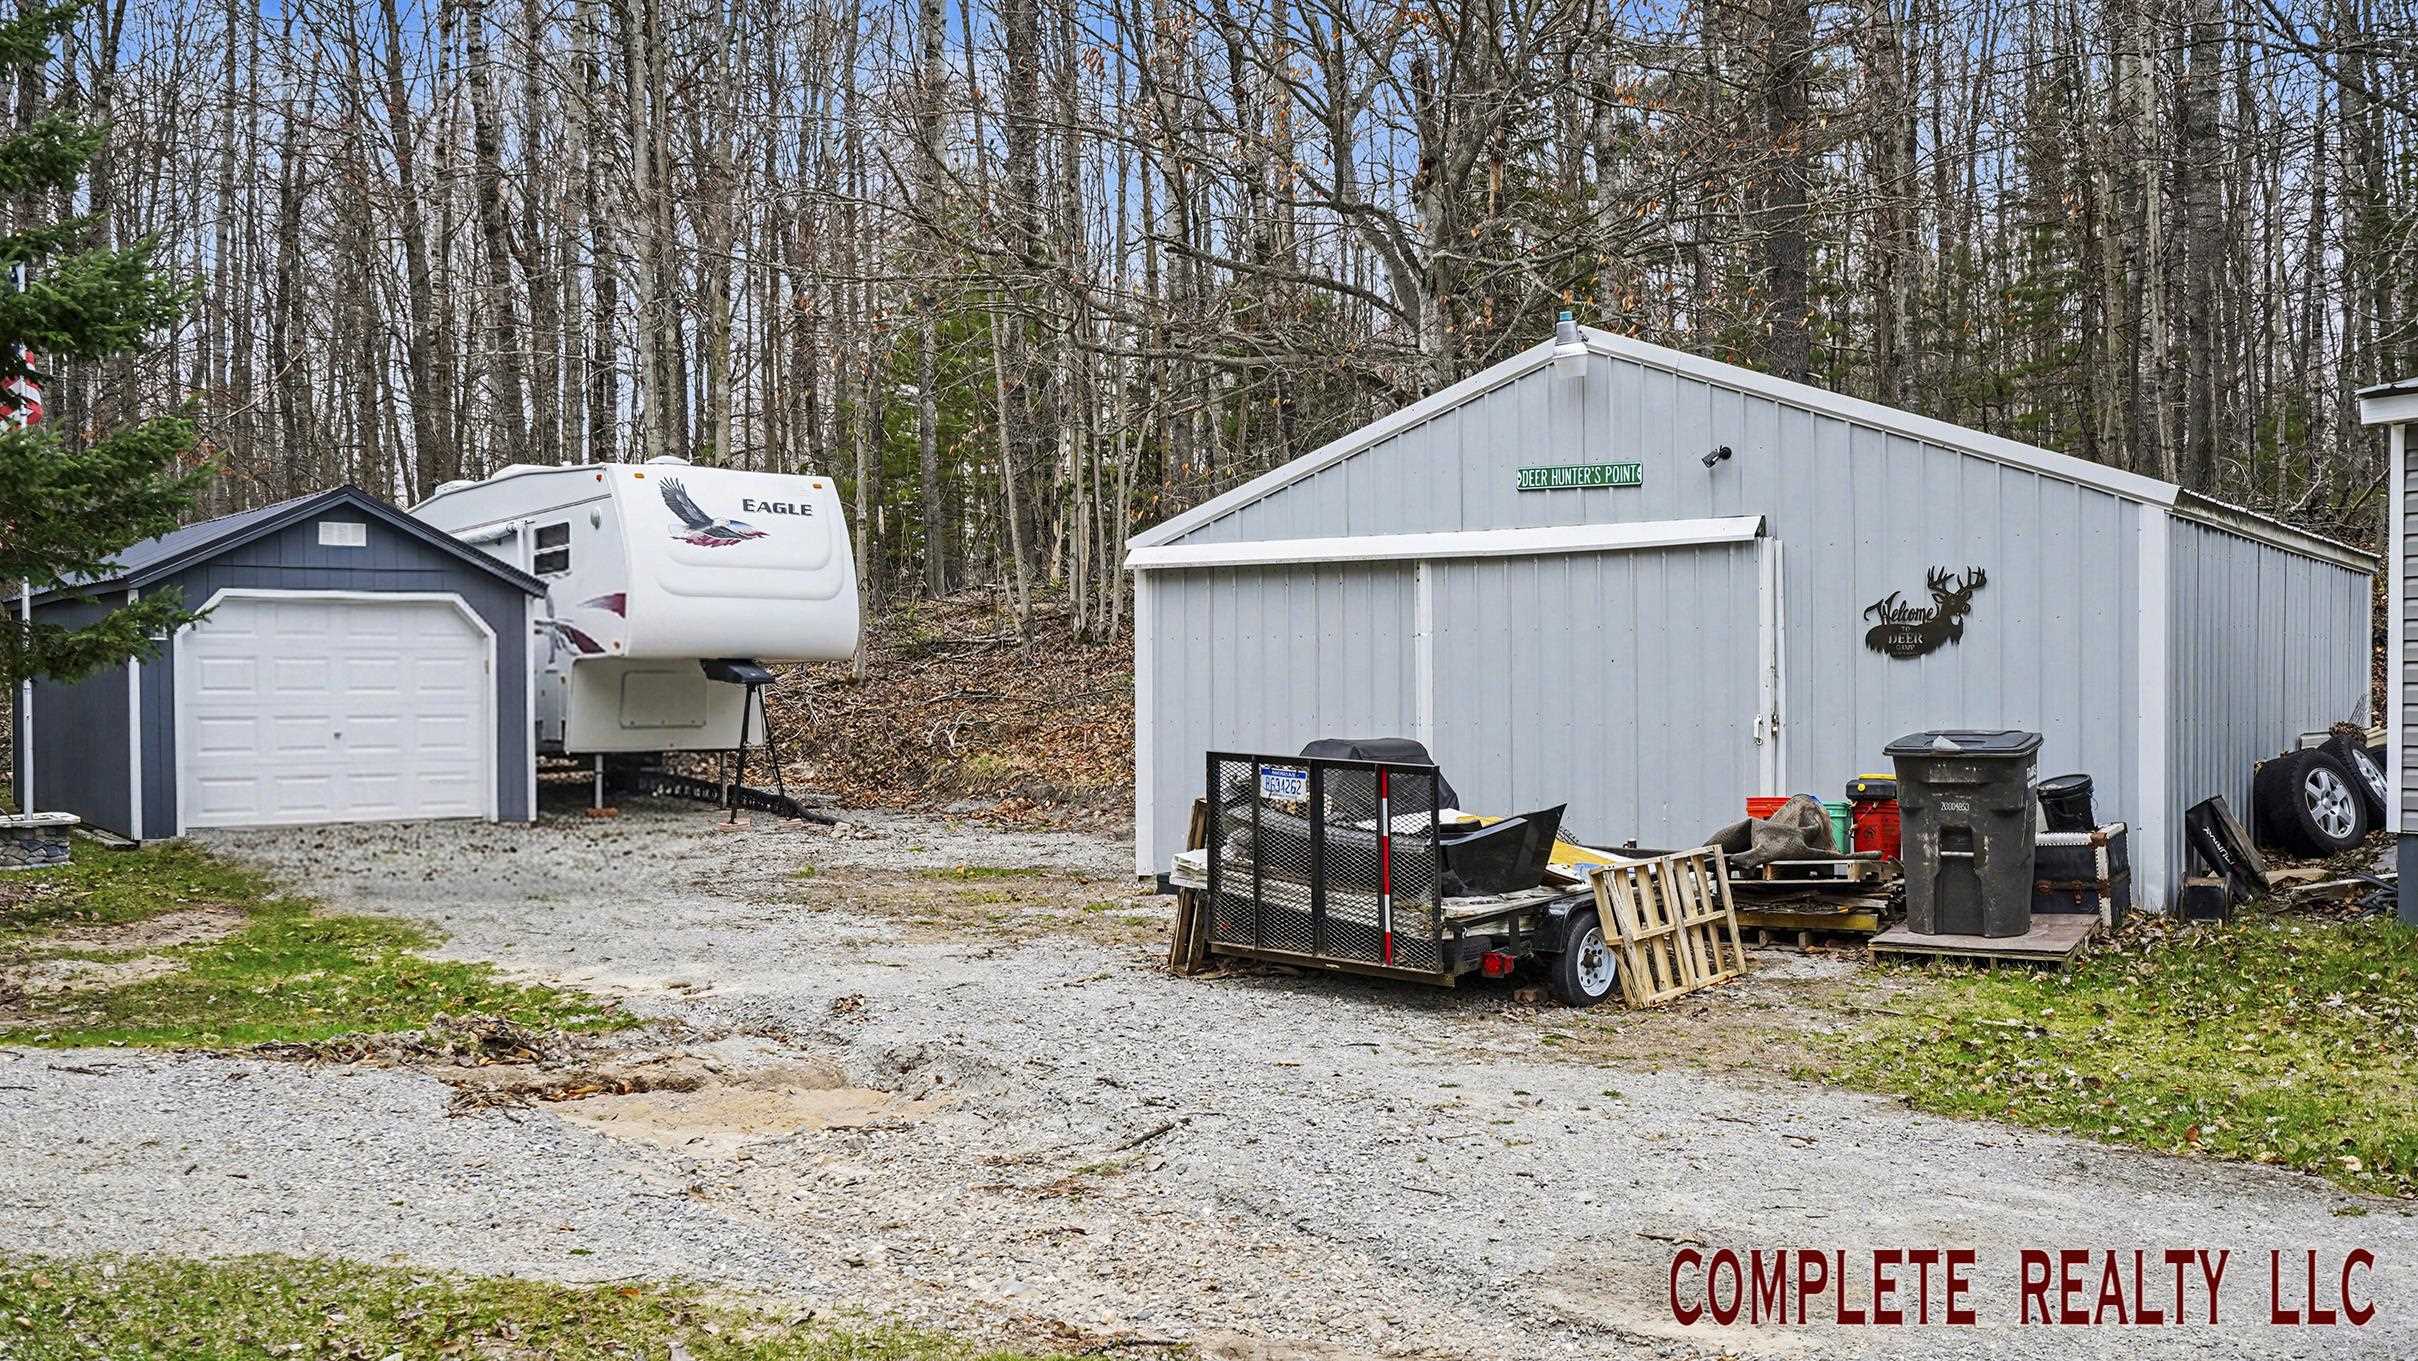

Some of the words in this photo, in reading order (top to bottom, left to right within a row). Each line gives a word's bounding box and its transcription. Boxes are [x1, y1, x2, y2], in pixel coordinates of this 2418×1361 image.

[1521, 469, 1548, 487] DEER
[1551, 466, 1601, 486] HUNTER'S
[1605, 464, 1638, 483] POINT
[742, 498, 813, 516] EAGLE
[1863, 590, 1939, 626] Welcome
[1888, 633, 1923, 644] DEER
